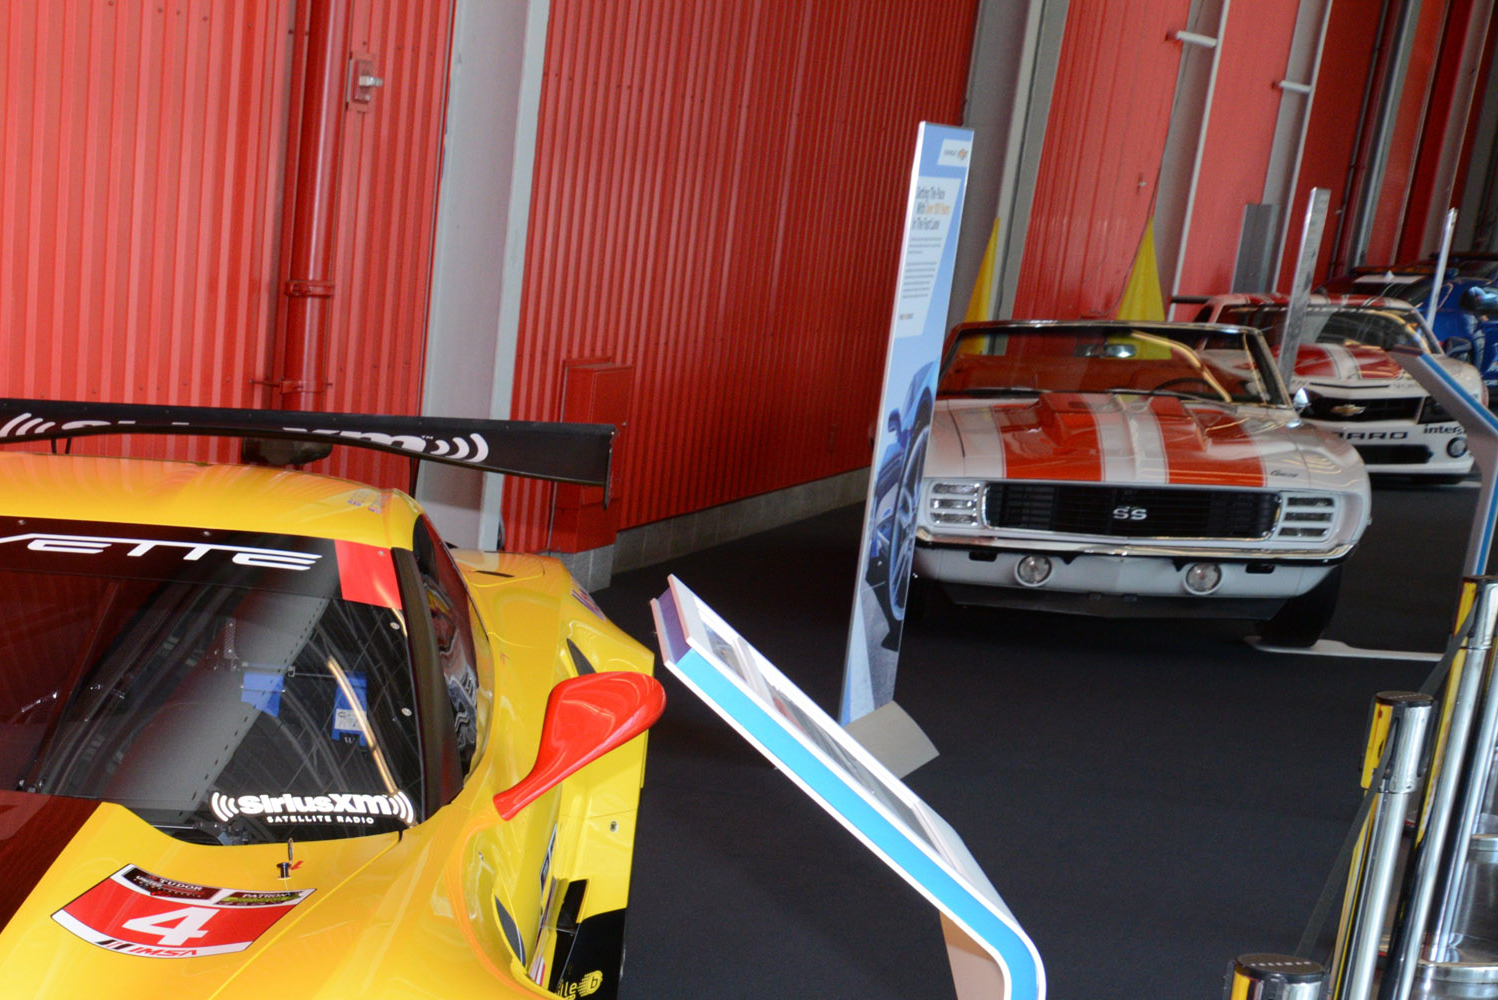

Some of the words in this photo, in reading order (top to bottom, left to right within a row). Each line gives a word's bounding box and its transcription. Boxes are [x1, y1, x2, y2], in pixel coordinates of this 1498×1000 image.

[1112, 506, 1148, 520] SS
[266, 815, 332, 823] SATELLITE
[336, 815, 375, 825] RADIO
[159, 879, 203, 891] TUDOR
[121, 906, 221, 946] 4
[128, 946, 199, 957] IMSA
